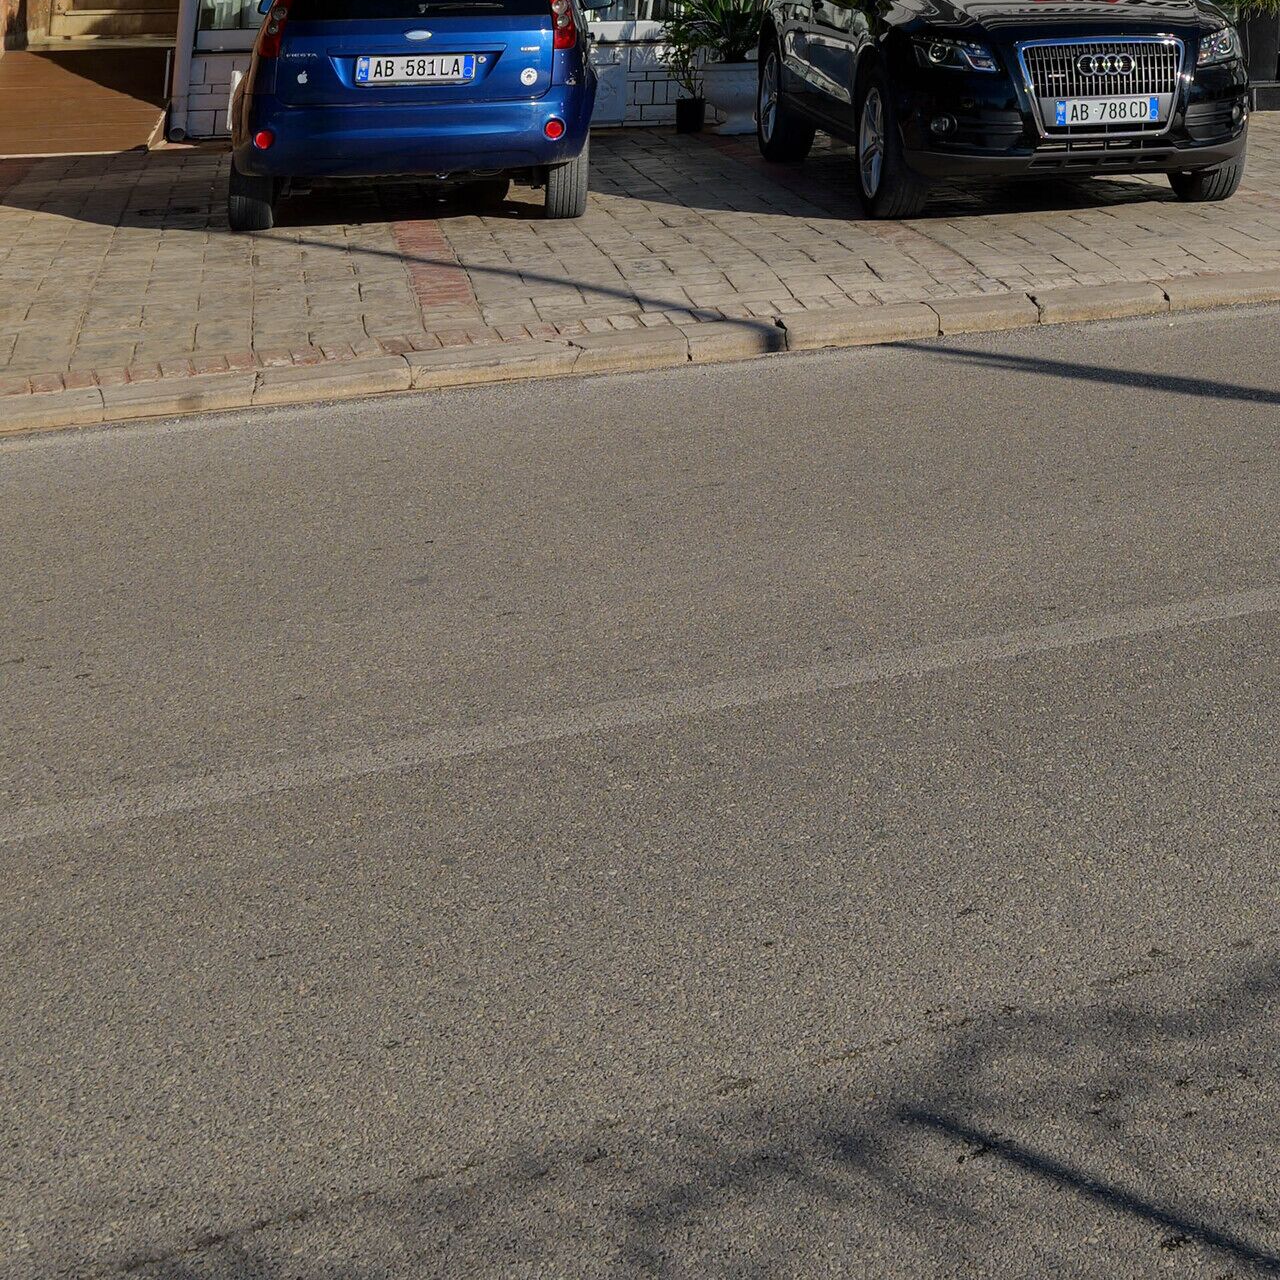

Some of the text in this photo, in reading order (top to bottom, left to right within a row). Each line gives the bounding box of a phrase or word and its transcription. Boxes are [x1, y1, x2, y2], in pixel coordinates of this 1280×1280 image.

[373, 57, 461, 78] AB 581LA
[1070, 101, 1148, 121] AB 788CD
